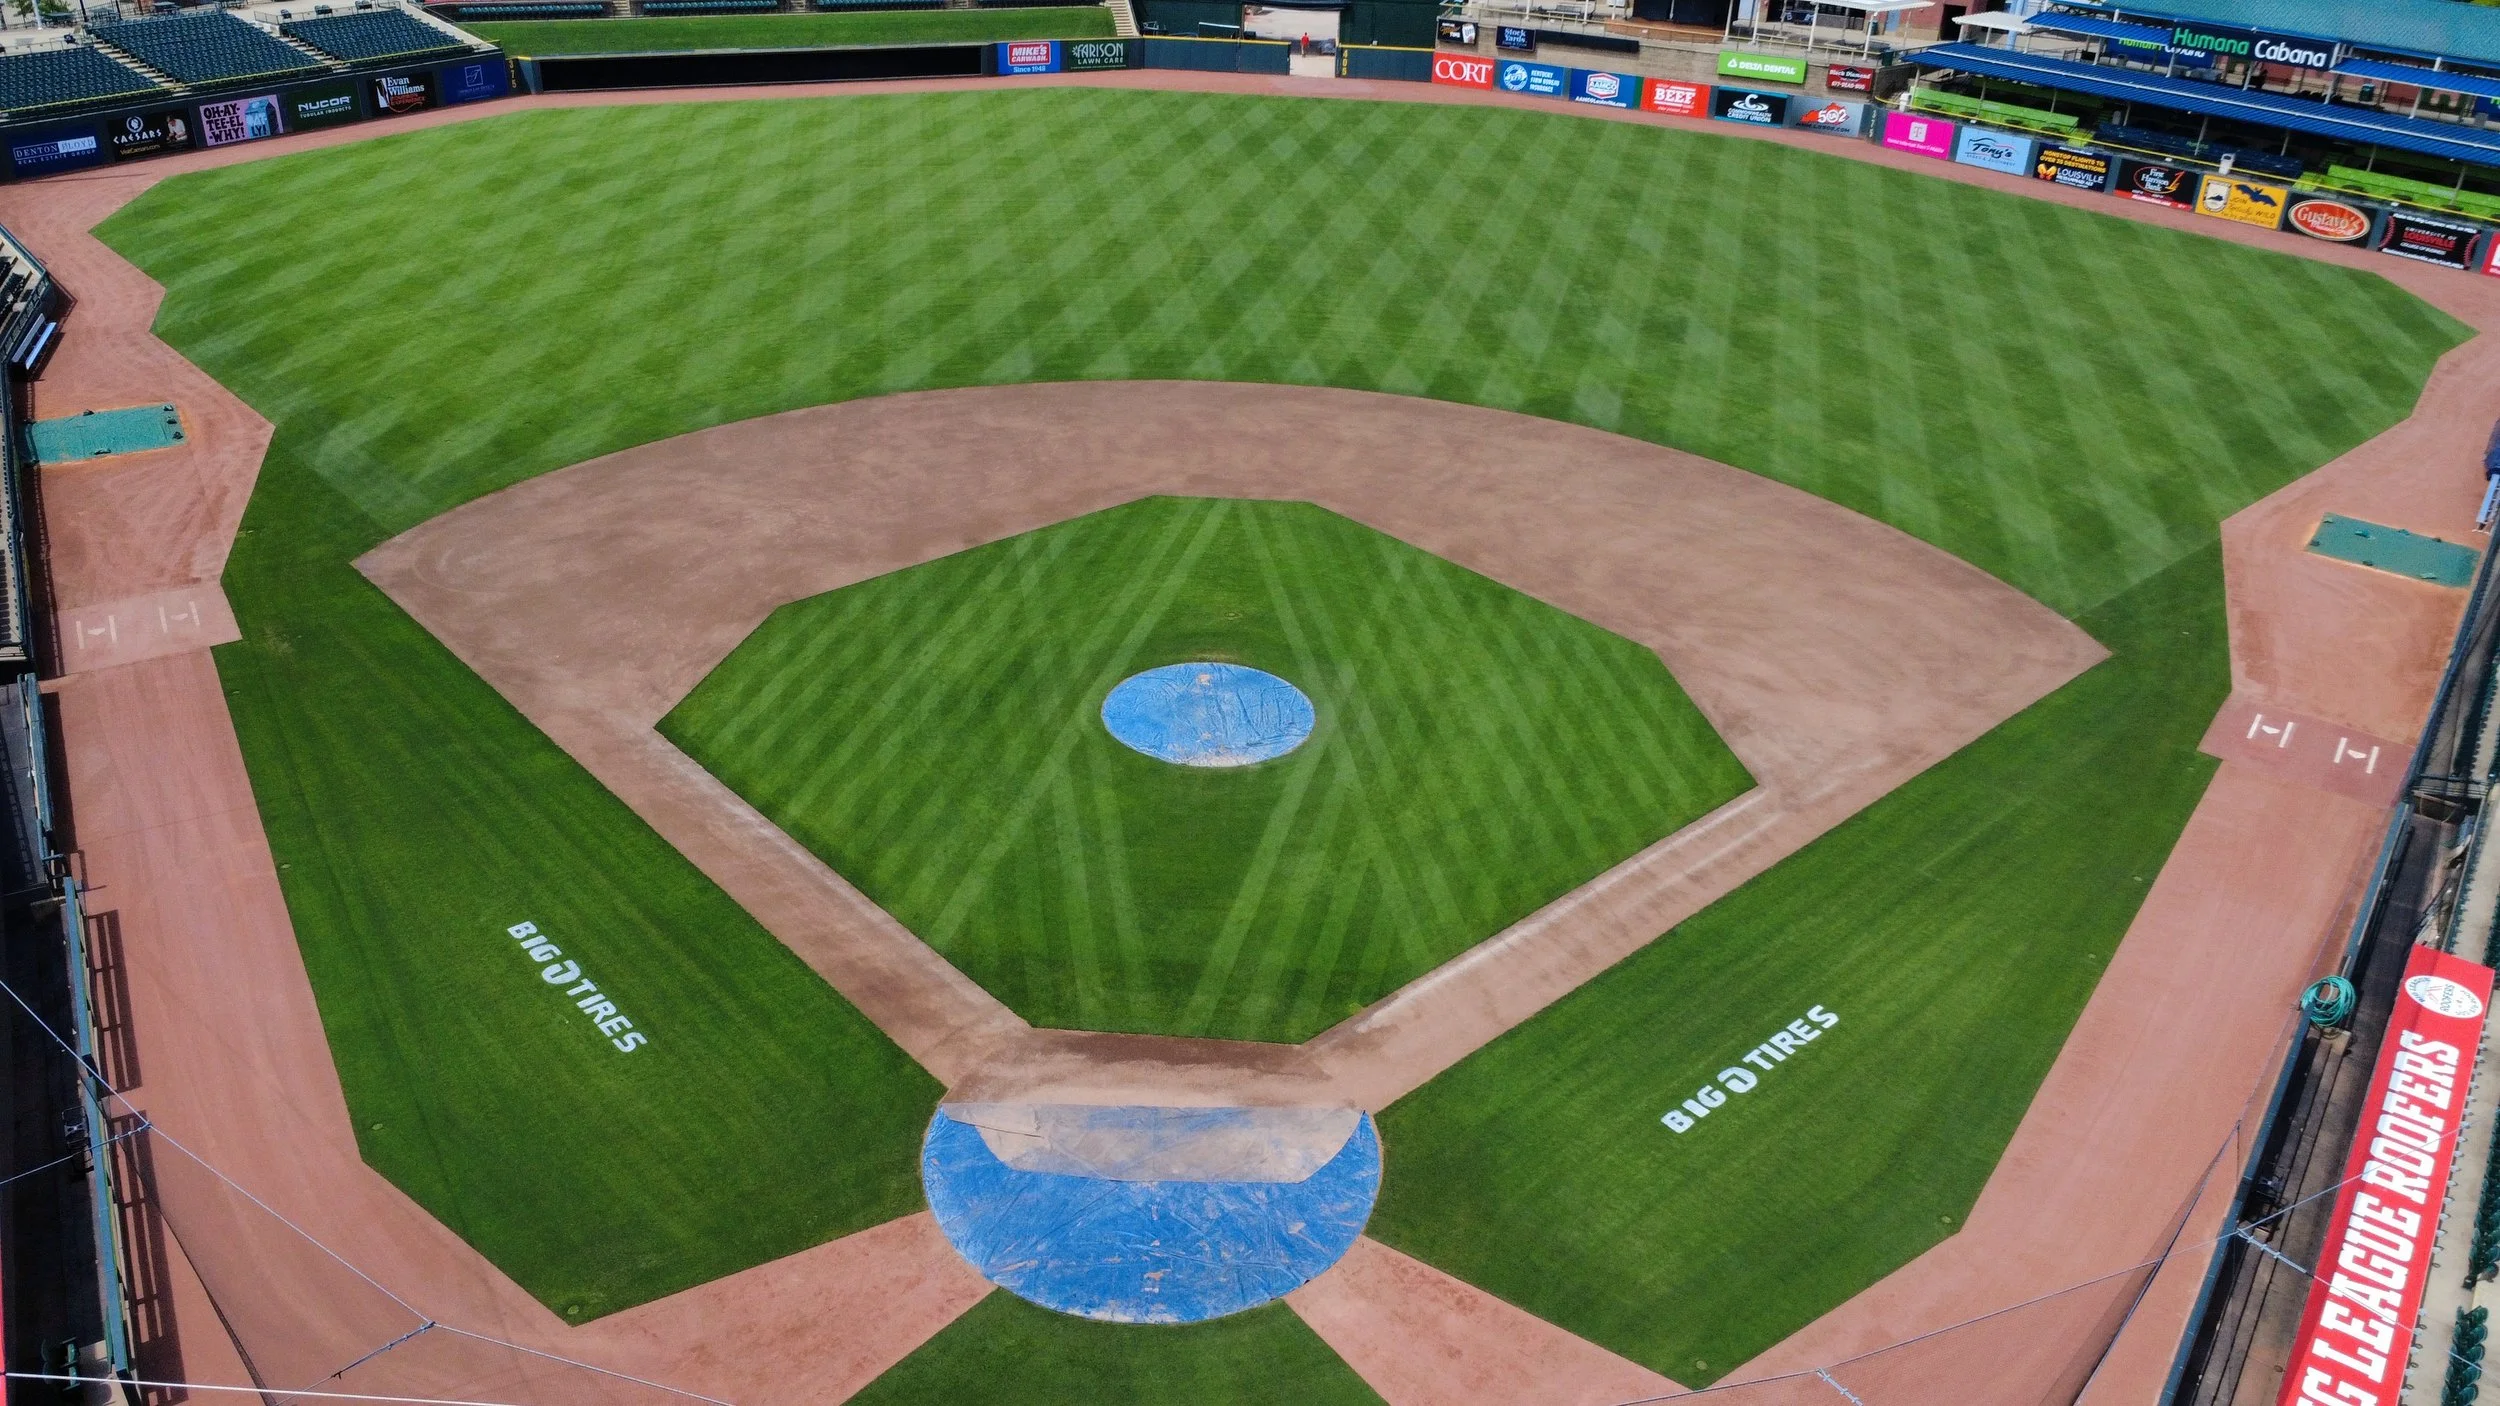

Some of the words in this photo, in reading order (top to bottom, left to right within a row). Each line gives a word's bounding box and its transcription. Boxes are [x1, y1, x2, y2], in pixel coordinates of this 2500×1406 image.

[1504, 28, 1526, 37] Stock
[1012, 45, 1048, 56] MIKE'S
[2173, 27, 2249, 55] Humana
[2254, 39, 2328, 68] Cabana
[1435, 59, 1491, 83] CORT
[1738, 61, 1763, 71] DELTA
[1763, 64, 1796, 75] DENTAL
[387, 76, 410, 87] Evan
[387, 84, 425, 96] Williams
[1654, 87, 1697, 105] BEEF
[203, 103, 240, 119] OH-AY-
[298, 97, 350, 111] NUCOR
[206, 115, 244, 132] TEE-EL
[113, 128, 162, 144] CAESARS
[15, 144, 58, 158] DENTON
[40, 153, 67, 162] ESTATE
[71, 149, 96, 157] GROUP
[1972, 143, 2013, 159] Tony's
[2043, 149, 2072, 160] NONSTOP
[2071, 155, 2096, 165] FLIGHTS
[2039, 155, 2056, 163] OVER
[2063, 160, 2107, 173] DESTINATIONS
[2057, 167, 2105, 184] LOUISVILLE
[2297, 206, 2361, 230] Gustavo's
[2403, 230, 2457, 249] LOUISVILLE
[507, 920, 562, 963] BIG
[566, 978, 648, 1053] TIRES
[1660, 1084, 1727, 1134] BIG
[1742, 1004, 1840, 1071] TIRES
[2361, 1029, 2461, 1205] ROOFERS
[2311, 1191, 2423, 1384] LEAGUE
